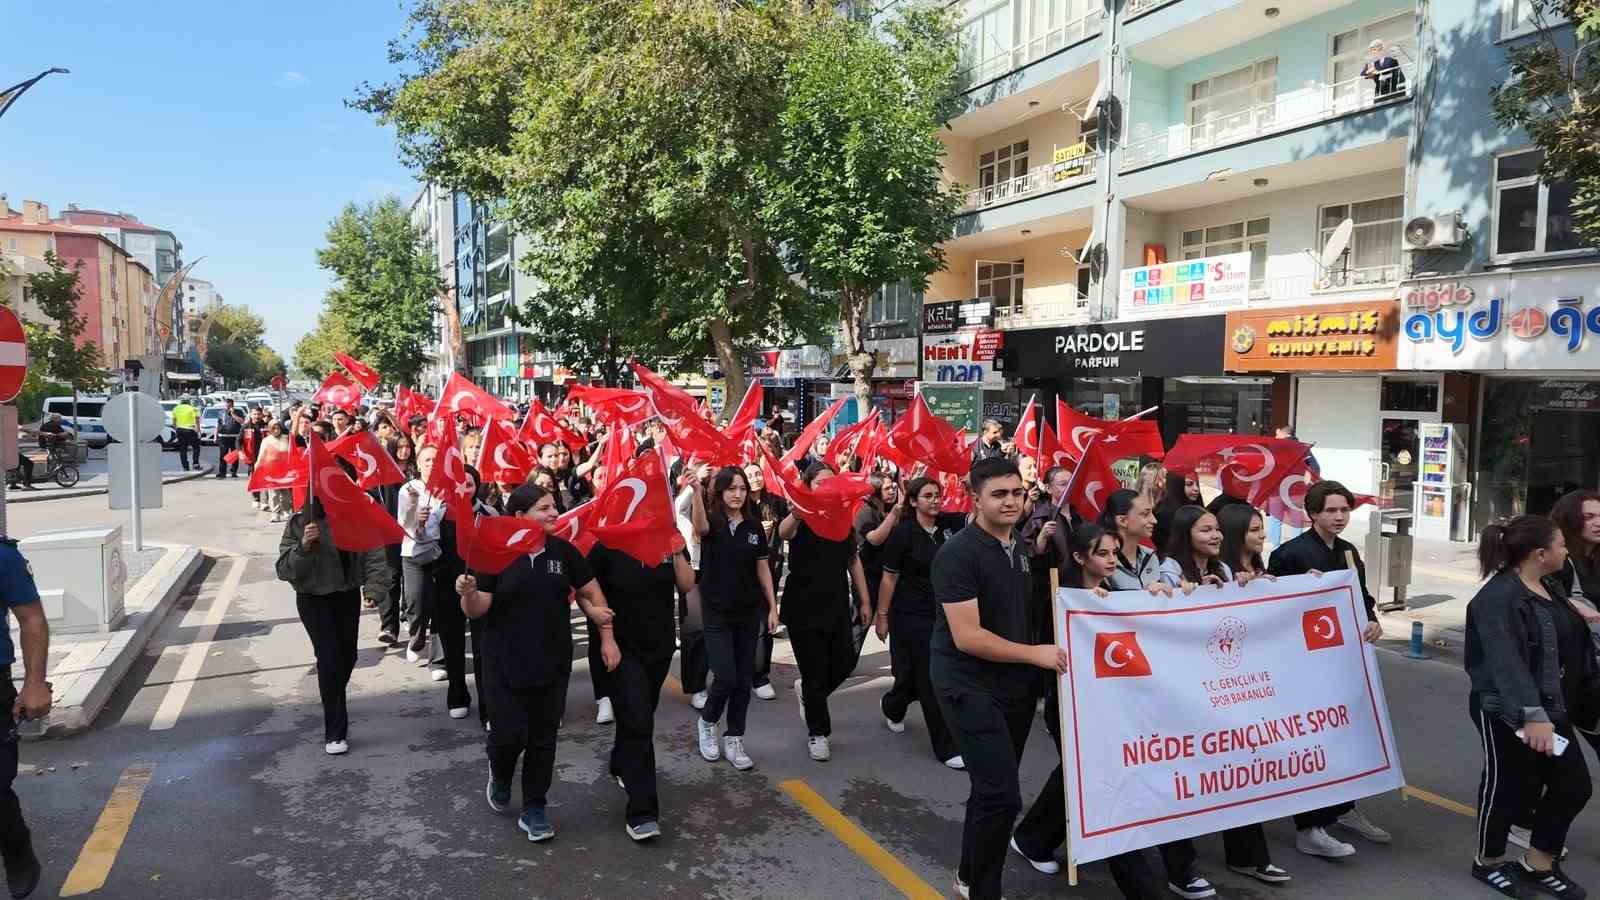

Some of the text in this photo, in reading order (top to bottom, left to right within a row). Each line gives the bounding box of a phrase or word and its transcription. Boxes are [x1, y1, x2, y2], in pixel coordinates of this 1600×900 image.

[1055, 330, 1144, 354] PARDOLE
[1219, 671, 1257, 689] GENÇLİK
[1258, 670, 1271, 683] VE
[1210, 686, 1276, 708] SPOR BAKANLIĞI
[1122, 704, 1350, 768] NİĞDE GENÇLİK VE SPOR
[1174, 744, 1327, 801] İL MÜDÜRLÜĞÜ
